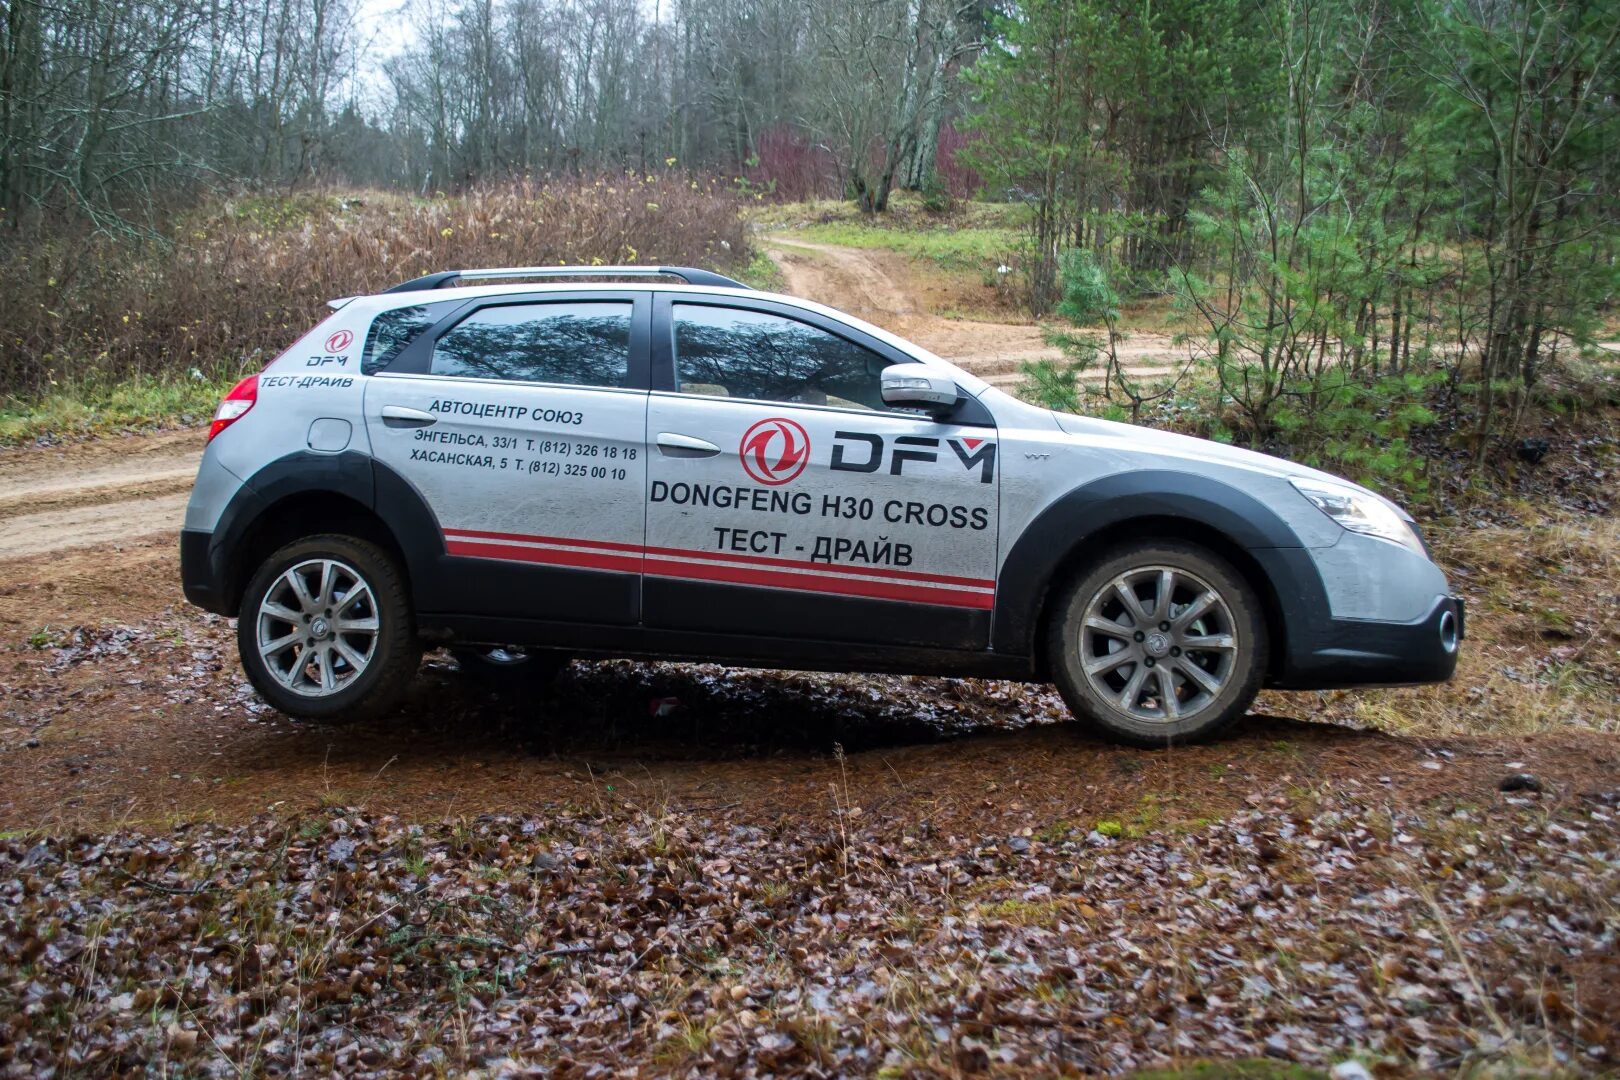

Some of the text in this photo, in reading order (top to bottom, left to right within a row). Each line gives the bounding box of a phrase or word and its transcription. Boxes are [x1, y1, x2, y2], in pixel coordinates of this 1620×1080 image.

[306, 355, 349, 367] DFM
[429, 400, 583, 425] АВТОЦЕНТР СОЮЗ
[414, 429, 637, 461] ЭНГЕЛЬСА, 33/1 Т. (812) 326 18 18
[830, 431, 996, 484] DFM
[410, 449, 626, 481] ХАСАНСКАЯ, 5 Т. (812) 325 00 10
[651, 480, 990, 531] DONGFENG H30 CROSS
[713, 527, 787, 555] ТЕСТ
[810, 535, 914, 567] ДРАЙВ
